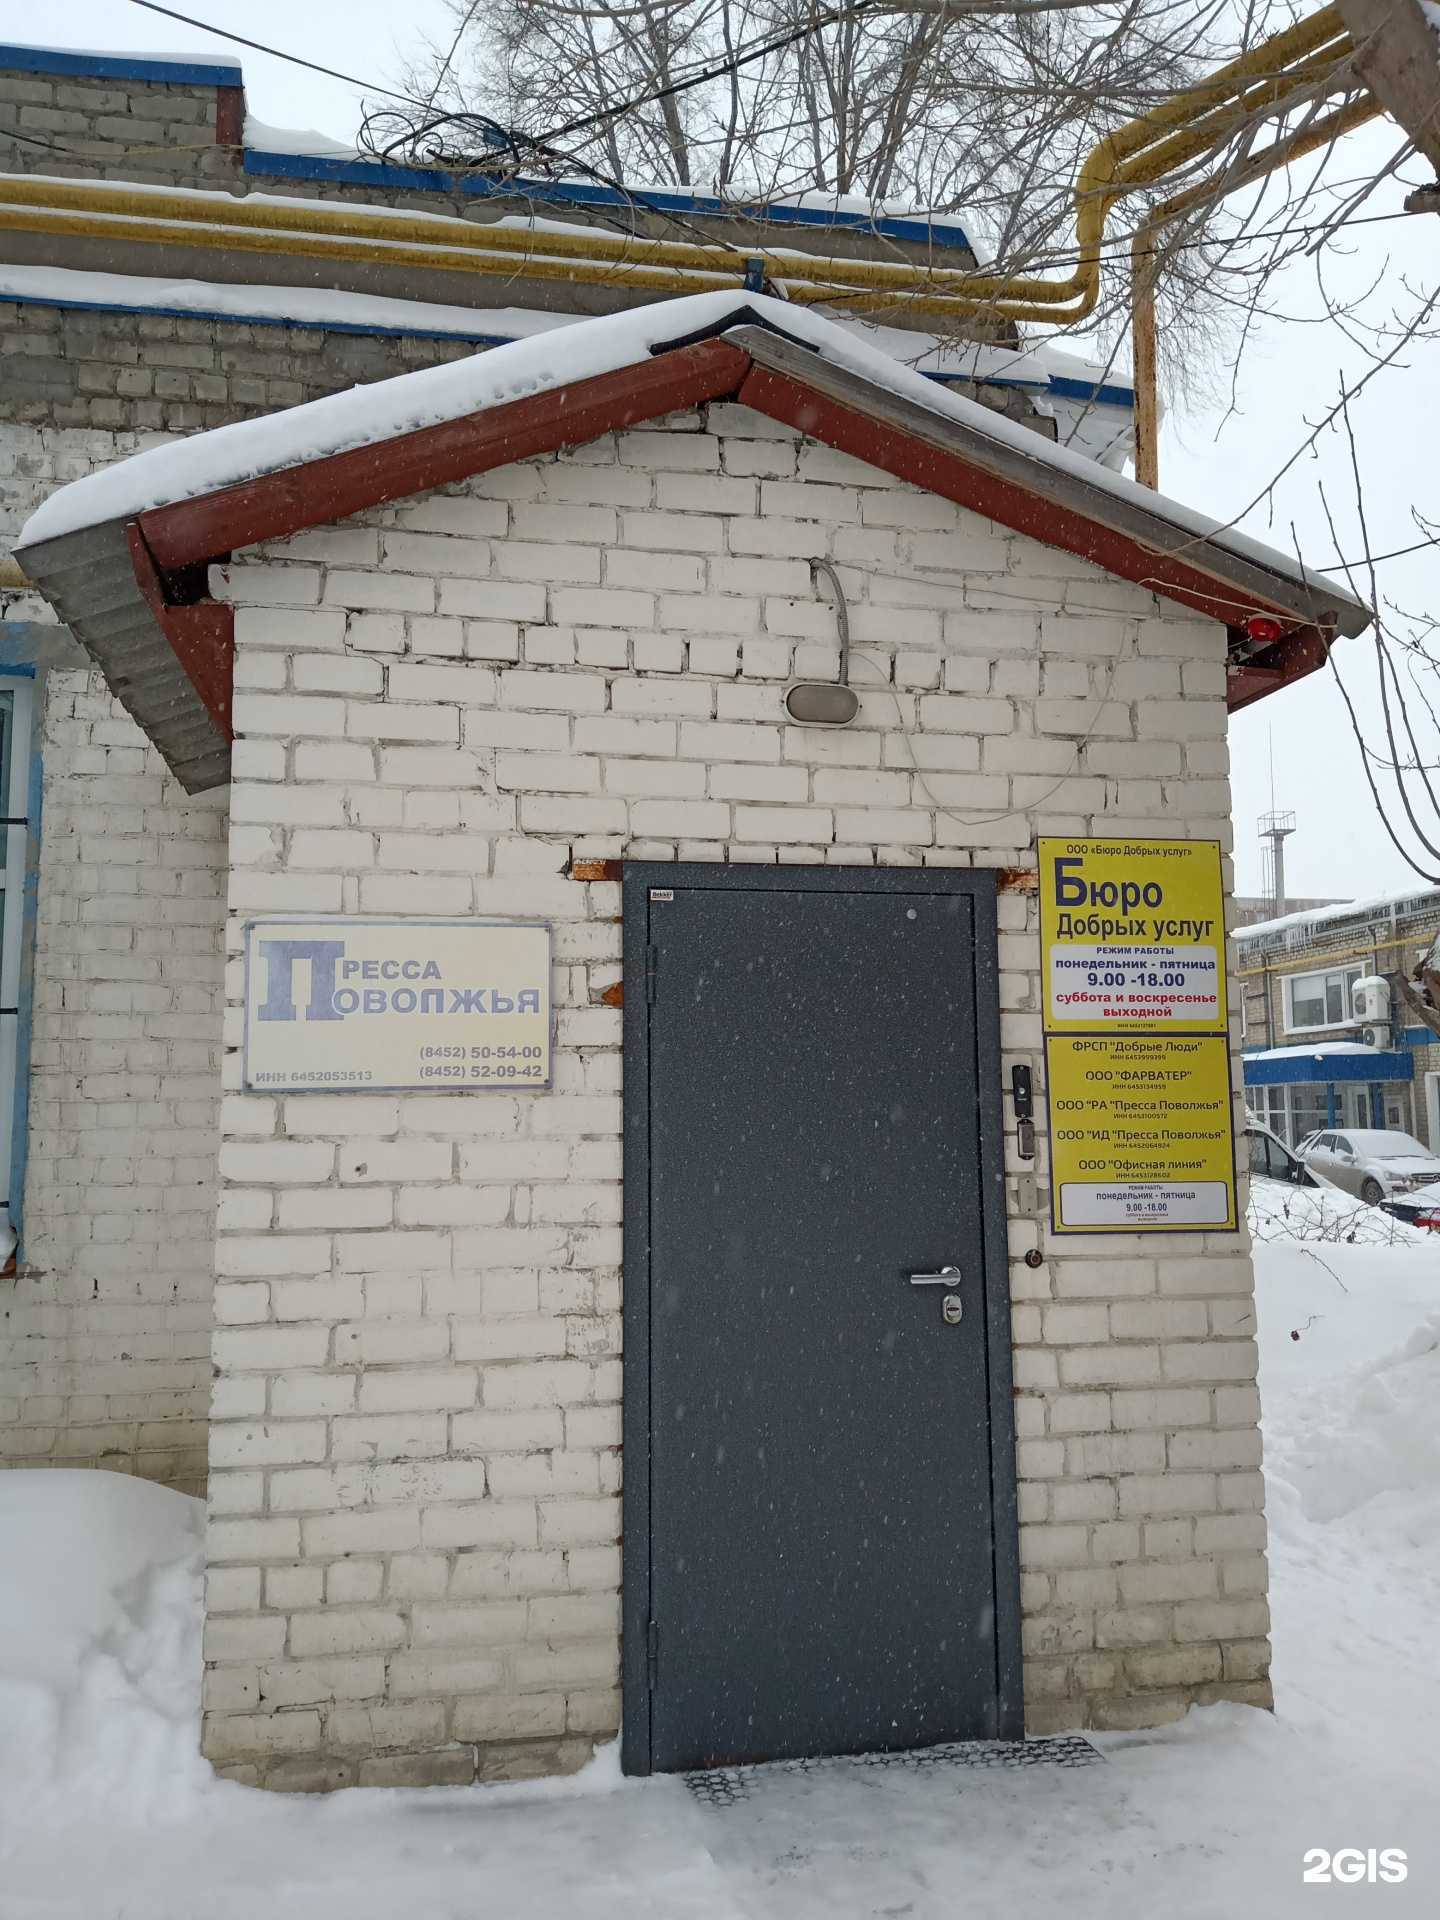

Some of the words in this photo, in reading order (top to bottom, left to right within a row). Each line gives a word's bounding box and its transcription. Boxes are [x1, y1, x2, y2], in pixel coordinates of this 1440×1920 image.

[1066, 844, 1088, 854] ООО
[1124, 846, 1160, 856] Добрых
[1054, 857, 1162, 916] Бюро
[1056, 913, 1146, 940] Добрых
[1153, 919, 1214, 942] услуг
[1096, 946, 1132, 954] РЕЖИМ
[1056, 959, 1147, 970] понедельник
[1160, 960, 1215, 971] пятница
[1087, 973, 1125, 986] 9.00
[1056, 992, 1111, 1003] суббота
[1116, 994, 1124, 1002] и
[1128, 994, 1217, 1003] воскресенье
[1103, 1007, 1172, 1017] выходной
[419, 1047, 466, 1059] (8452)
[471, 1046, 542, 1059] 50-54-00
[1072, 1041, 1108, 1051] ФРСП
[1110, 1041, 1162, 1053] "Добрые
[1165, 1041, 1202, 1052] Люди"
[255, 1072, 287, 1082] ИНН
[290, 1071, 373, 1082] 6452053513
[419, 1066, 466, 1079] (8452)
[471, 1065, 542, 1078] 52-09-42
[1086, 1071, 1113, 1080] ООО
[1116, 1071, 1192, 1081] "ФАРВАТЕР"
[1056, 1101, 1084, 1110] ООО
[1110, 1101, 1156, 1112] "Пресса
[1159, 1101, 1223, 1110] Поволжья"
[1057, 1130, 1084, 1140] ООО
[1113, 1130, 1158, 1142] "Пресса
[1161, 1130, 1225, 1140] Поволжья"
[1079, 1160, 1106, 1169] ООО
[1108, 1160, 1166, 1171] "Офисная
[1168, 1160, 1207, 1169] линия"
[1096, 1192, 1153, 1200] понедельник
[1161, 1192, 1196, 1200] пятница
